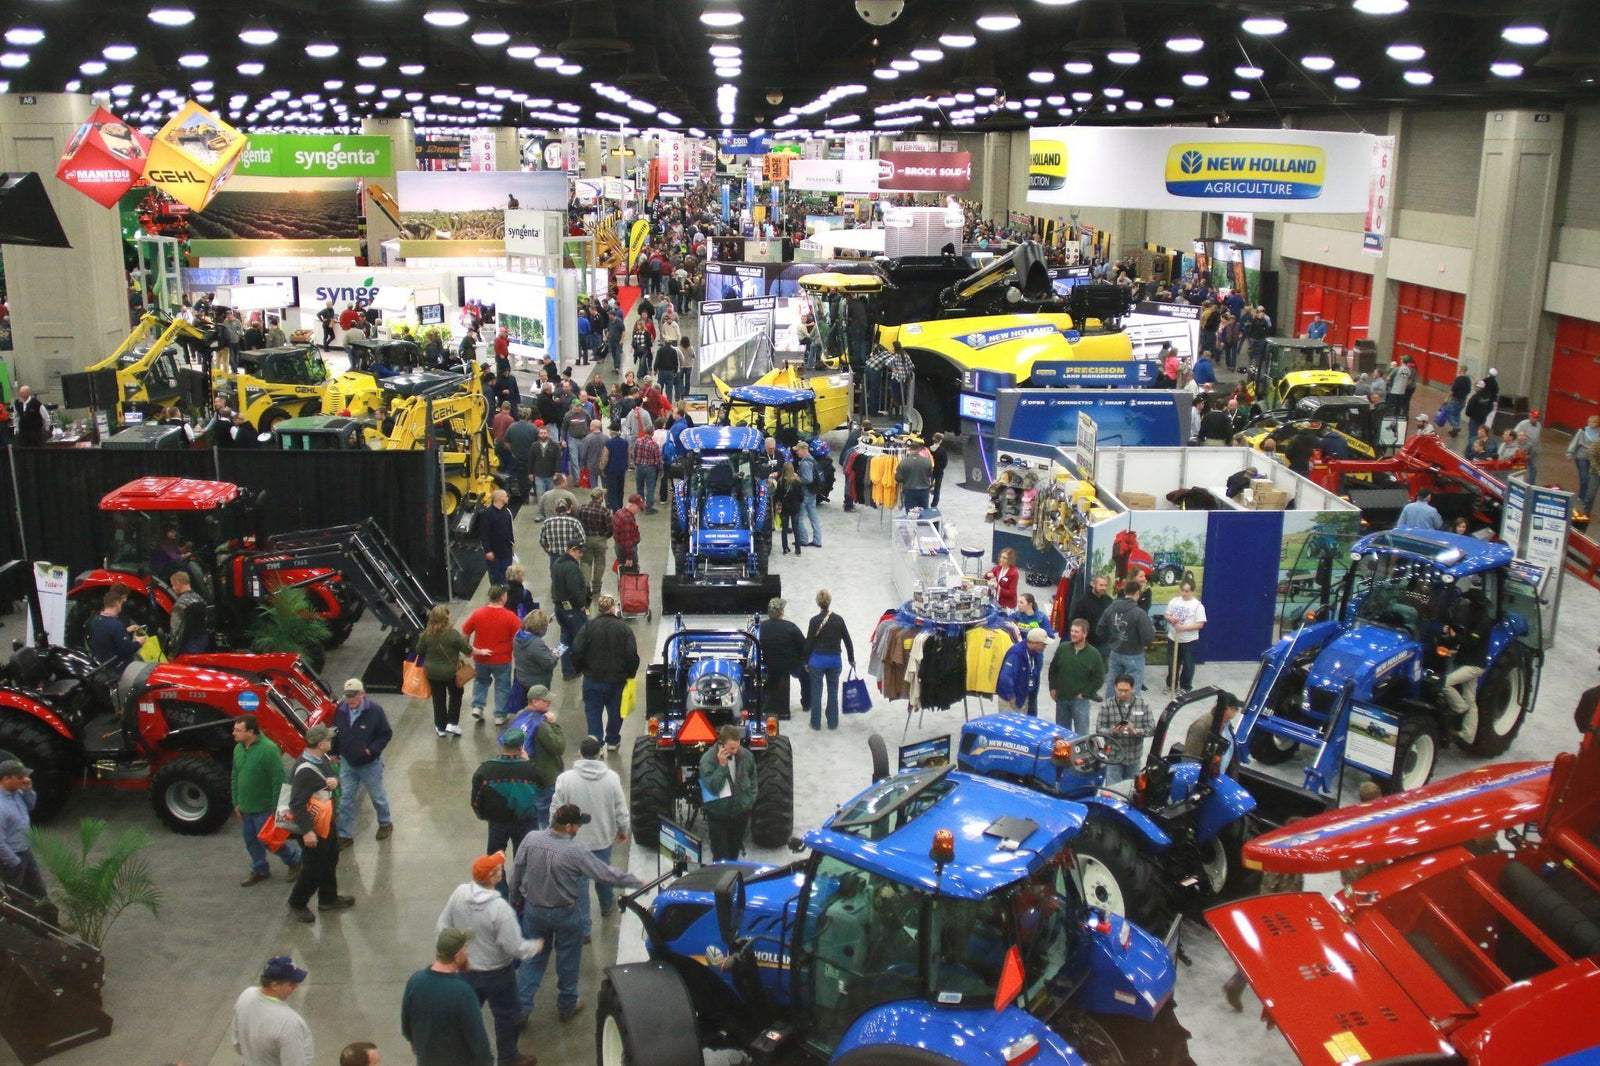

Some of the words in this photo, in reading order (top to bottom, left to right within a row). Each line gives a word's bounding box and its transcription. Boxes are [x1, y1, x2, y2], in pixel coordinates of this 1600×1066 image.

[239, 148, 271, 169] ngenta
[295, 148, 375, 170] syngenta
[672, 143, 680, 183] 6200
[1032, 153, 1061, 166] HOLLAND
[1207, 157, 1246, 171] NEW
[1250, 158, 1316, 173] HOLLAND
[77, 170, 130, 178] MANITOU
[148, 170, 205, 184] GEHL
[905, 167, 937, 176] BROCK
[939, 168, 962, 176] SOLID
[1030, 176, 1050, 186] RUCTION
[1204, 182, 1292, 195] AGRICULTURE
[1376, 154, 1387, 230] 6000
[508, 227, 540, 240] syngenta
[316, 286, 380, 307] synge
[989, 334, 1009, 342] NEW
[1010, 326, 1054, 338] HOLLAND
[295, 386, 318, 394] GEHL
[433, 406, 458, 420] GEHL
[1535, 506, 1565, 518] HERE
[1003, 741, 1029, 753] HOLLAND
